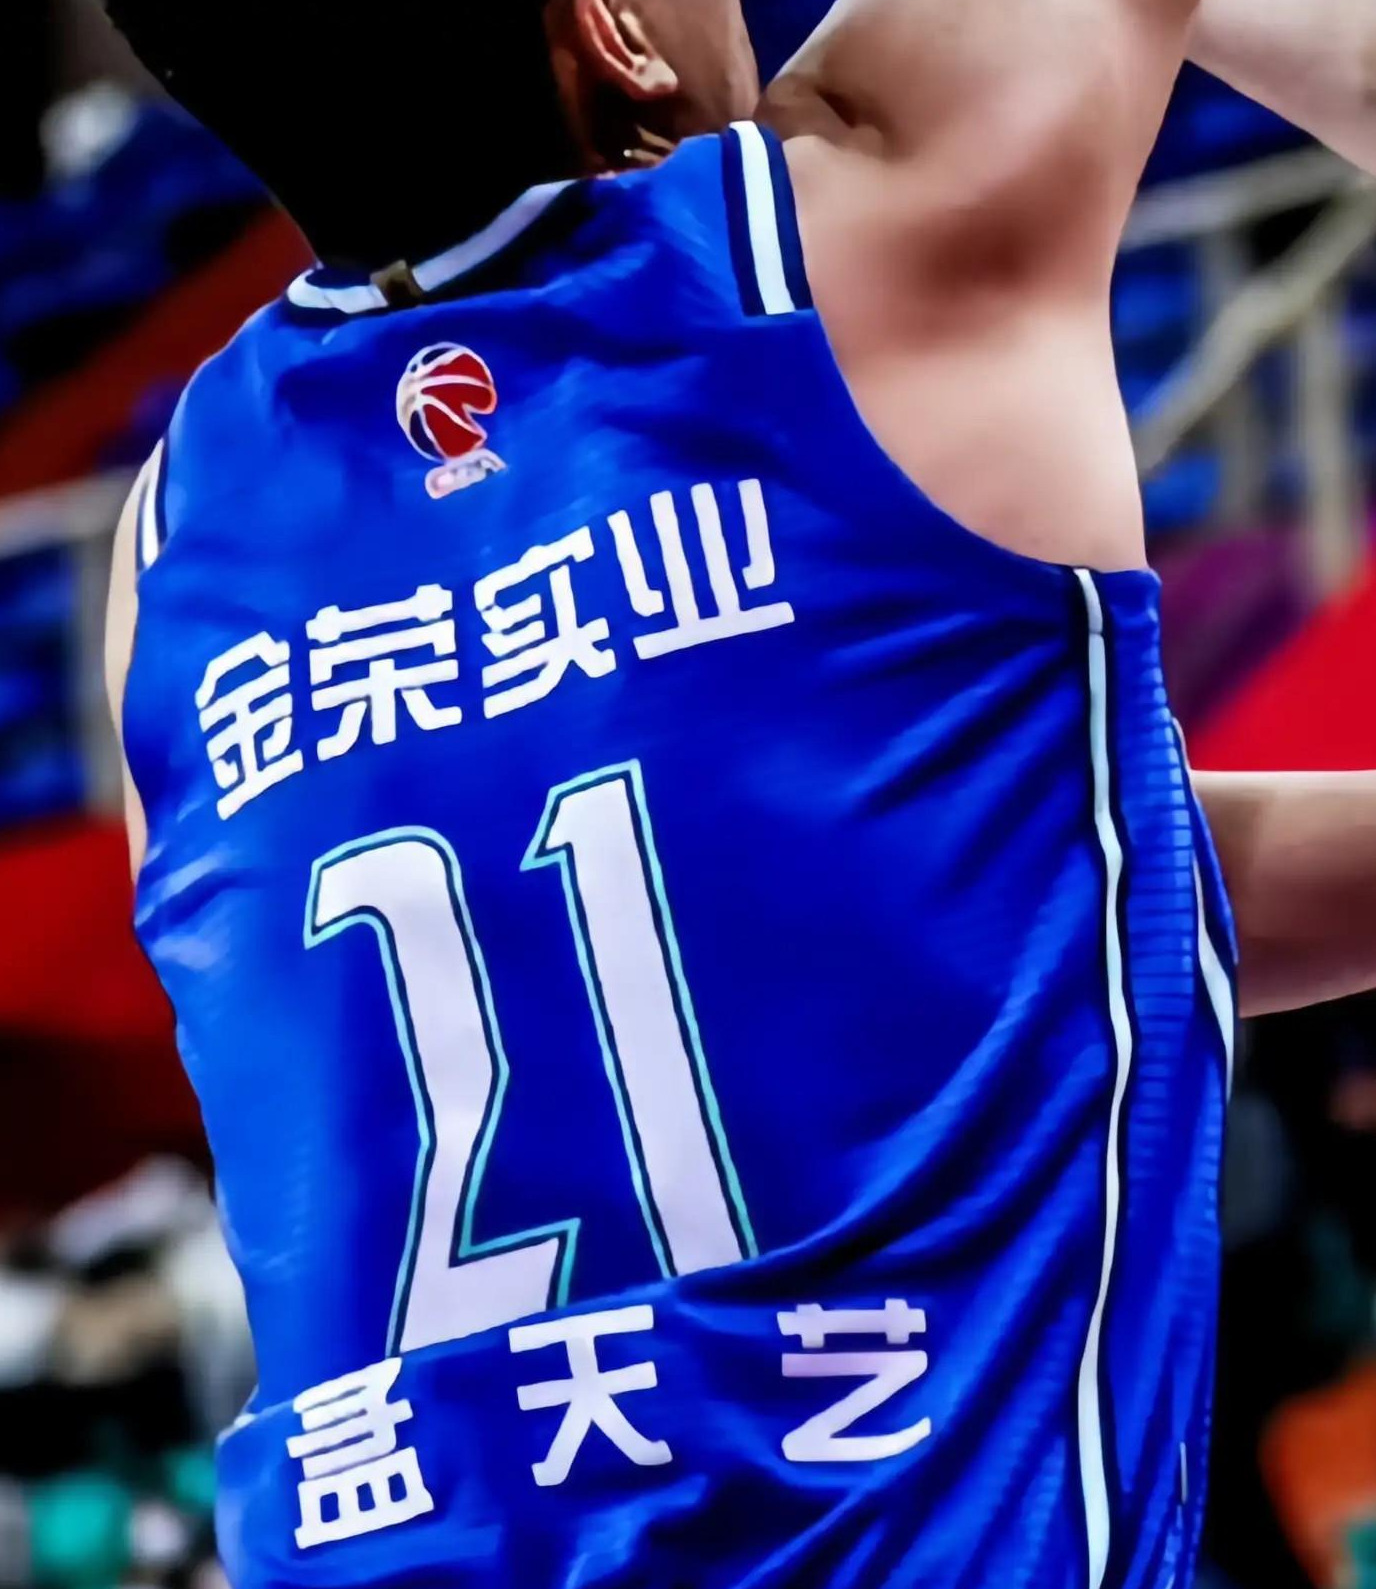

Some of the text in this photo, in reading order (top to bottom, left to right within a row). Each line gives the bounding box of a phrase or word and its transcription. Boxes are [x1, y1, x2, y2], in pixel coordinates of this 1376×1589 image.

[195, 478, 795, 820] 金荣实业
[304, 759, 758, 1357] 21
